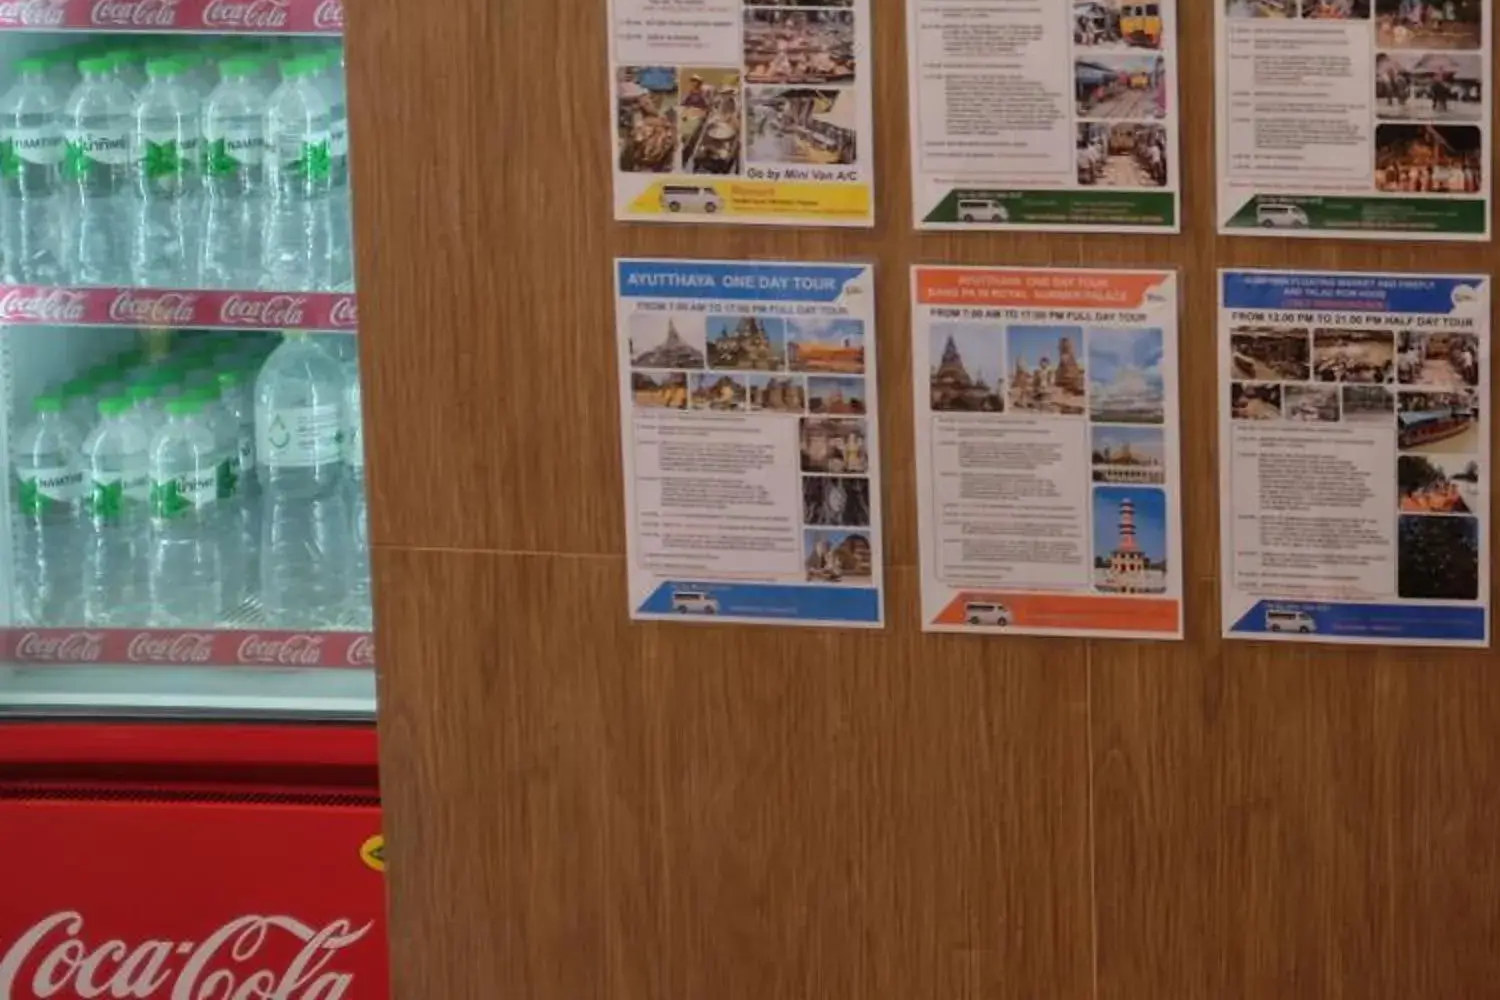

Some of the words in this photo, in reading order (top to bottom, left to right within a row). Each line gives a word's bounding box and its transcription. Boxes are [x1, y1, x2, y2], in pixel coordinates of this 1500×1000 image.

[747, 168, 763, 179] Go
[767, 169, 781, 180] by
[784, 169, 808, 180] Mini
[721, 273, 755, 288] ONE
[759, 274, 789, 289] DAY
[794, 276, 836, 290] TOUR
[1317, 314, 1331, 324] TO
[1366, 315, 1381, 325] PM
[1417, 316, 1439, 326] DAY
